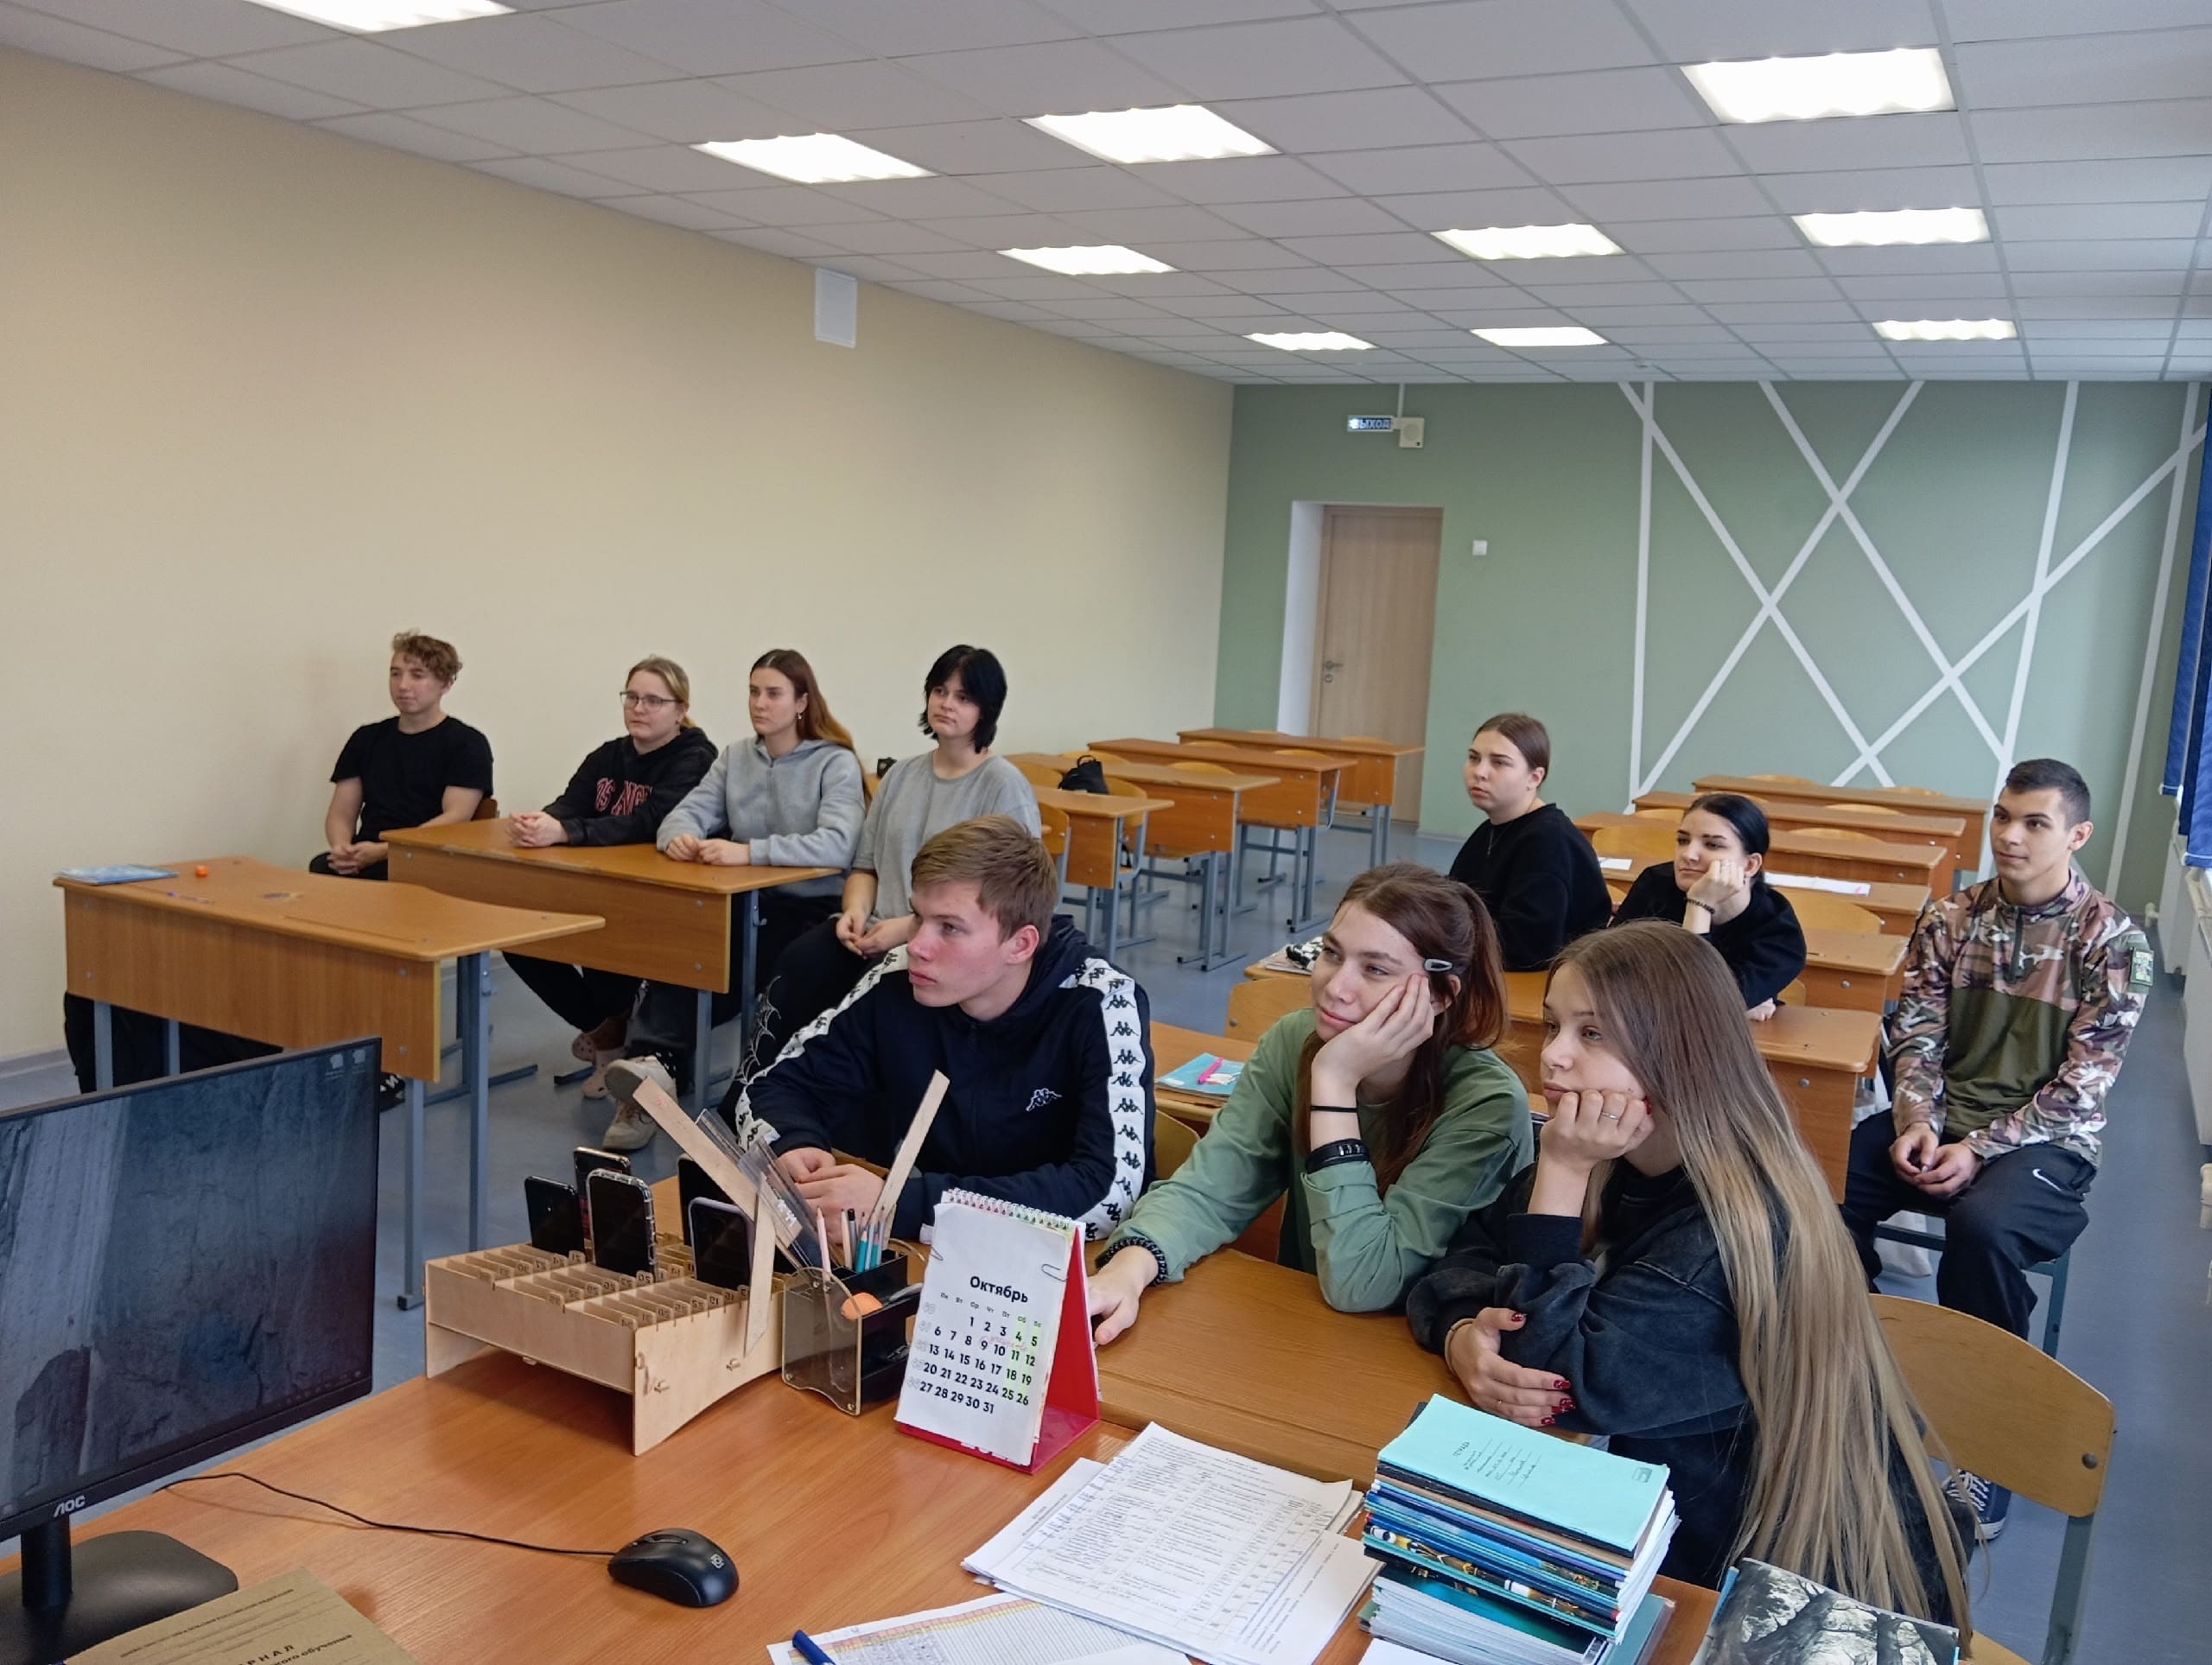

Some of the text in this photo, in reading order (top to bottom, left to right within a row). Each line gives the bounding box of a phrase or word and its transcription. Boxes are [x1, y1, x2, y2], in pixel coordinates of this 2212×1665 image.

[969, 1275, 1028, 1303] Октябрь
[934, 1326, 942, 1337] 6
[950, 1330, 957, 1341] 7
[964, 1335, 972, 1346] 8
[981, 1340, 988, 1350] 9
[994, 1344, 1006, 1357] 10
[1011, 1350, 1020, 1361] 11
[1026, 1354, 1036, 1367] 12
[969, 1316, 975, 1327] 1
[983, 1321, 991, 1332] 2
[1000, 1326, 1007, 1337] 3
[1015, 1331, 1022, 1342] 4
[1031, 1336, 1038, 1347] 5
[929, 1344, 940, 1356] 13
[944, 1348, 955, 1361] 14
[960, 1353, 971, 1365] 15
[975, 1358, 986, 1370] 16
[991, 1363, 1002, 1376] 17
[1007, 1368, 1017, 1381] 18
[1021, 1373, 1032, 1386] 19
[919, 1381, 933, 1393] 27
[934, 1386, 949, 1399] 28
[950, 1391, 964, 1403] 29
[965, 1395, 980, 1409] 30
[982, 1401, 995, 1414] 31
[923, 1362, 938, 1375] 20
[939, 1367, 952, 1380] 21
[954, 1372, 968, 1385] 22
[969, 1377, 983, 1390] 23
[985, 1382, 999, 1395] 24
[1001, 1387, 1014, 1401] 25
[1016, 1393, 1029, 1407] 26
[54, 1495, 86, 1517] AOC
